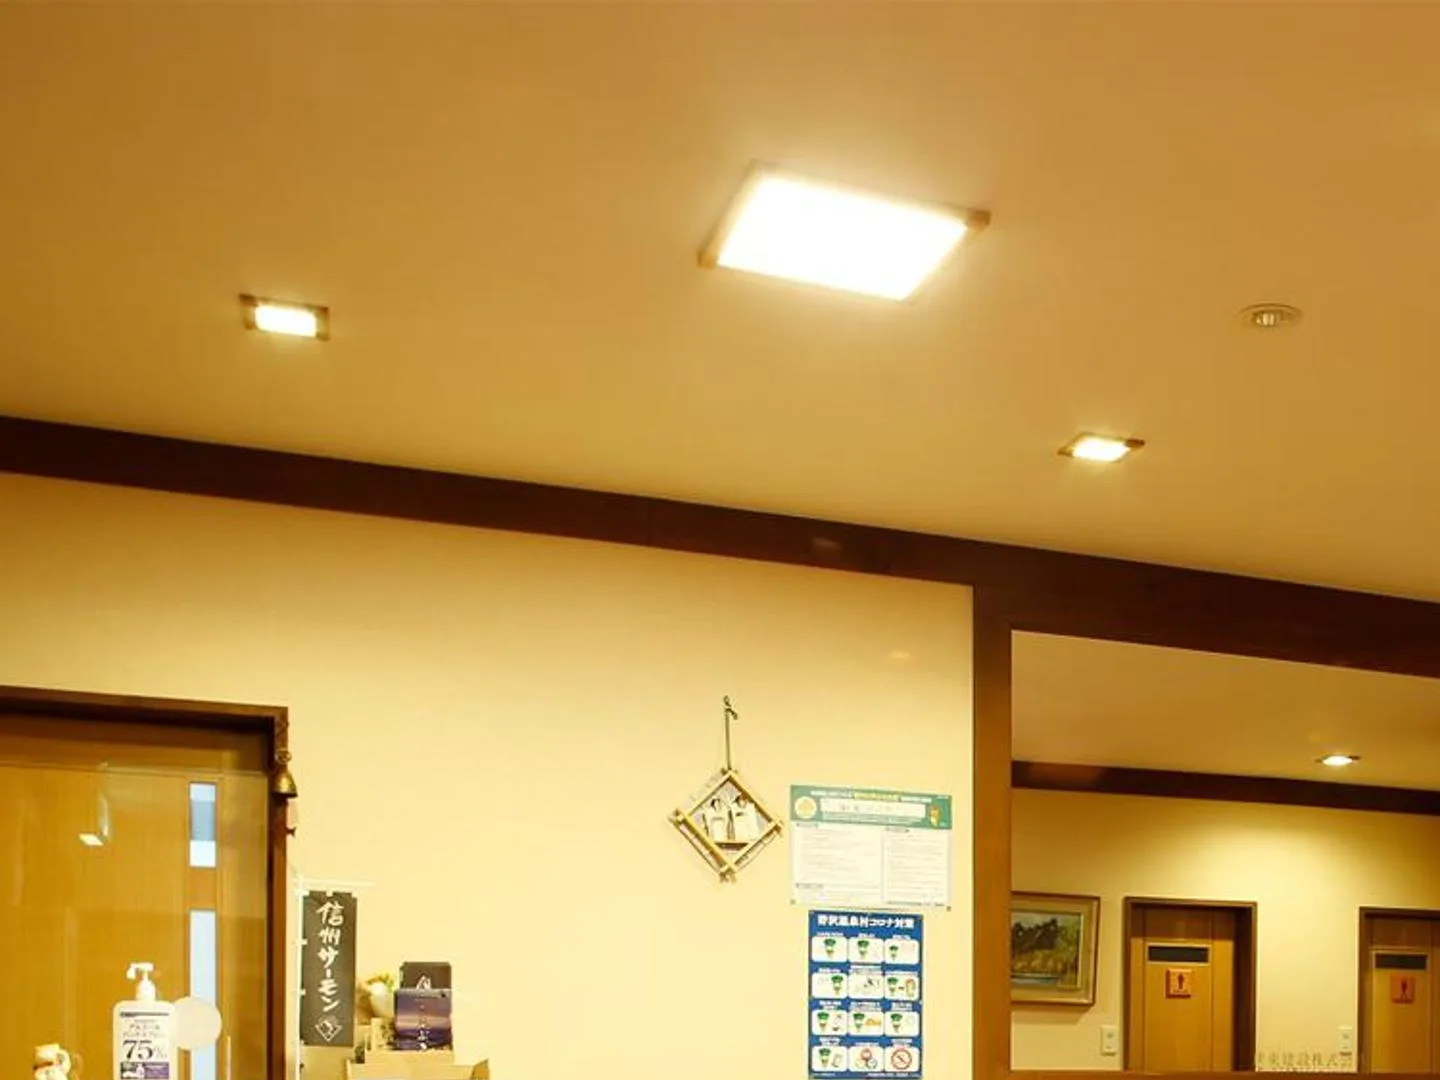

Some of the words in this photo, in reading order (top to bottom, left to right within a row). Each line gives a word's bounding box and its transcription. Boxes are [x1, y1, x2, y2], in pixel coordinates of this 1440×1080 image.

[316, 901, 345, 1012] 信州サーモン
